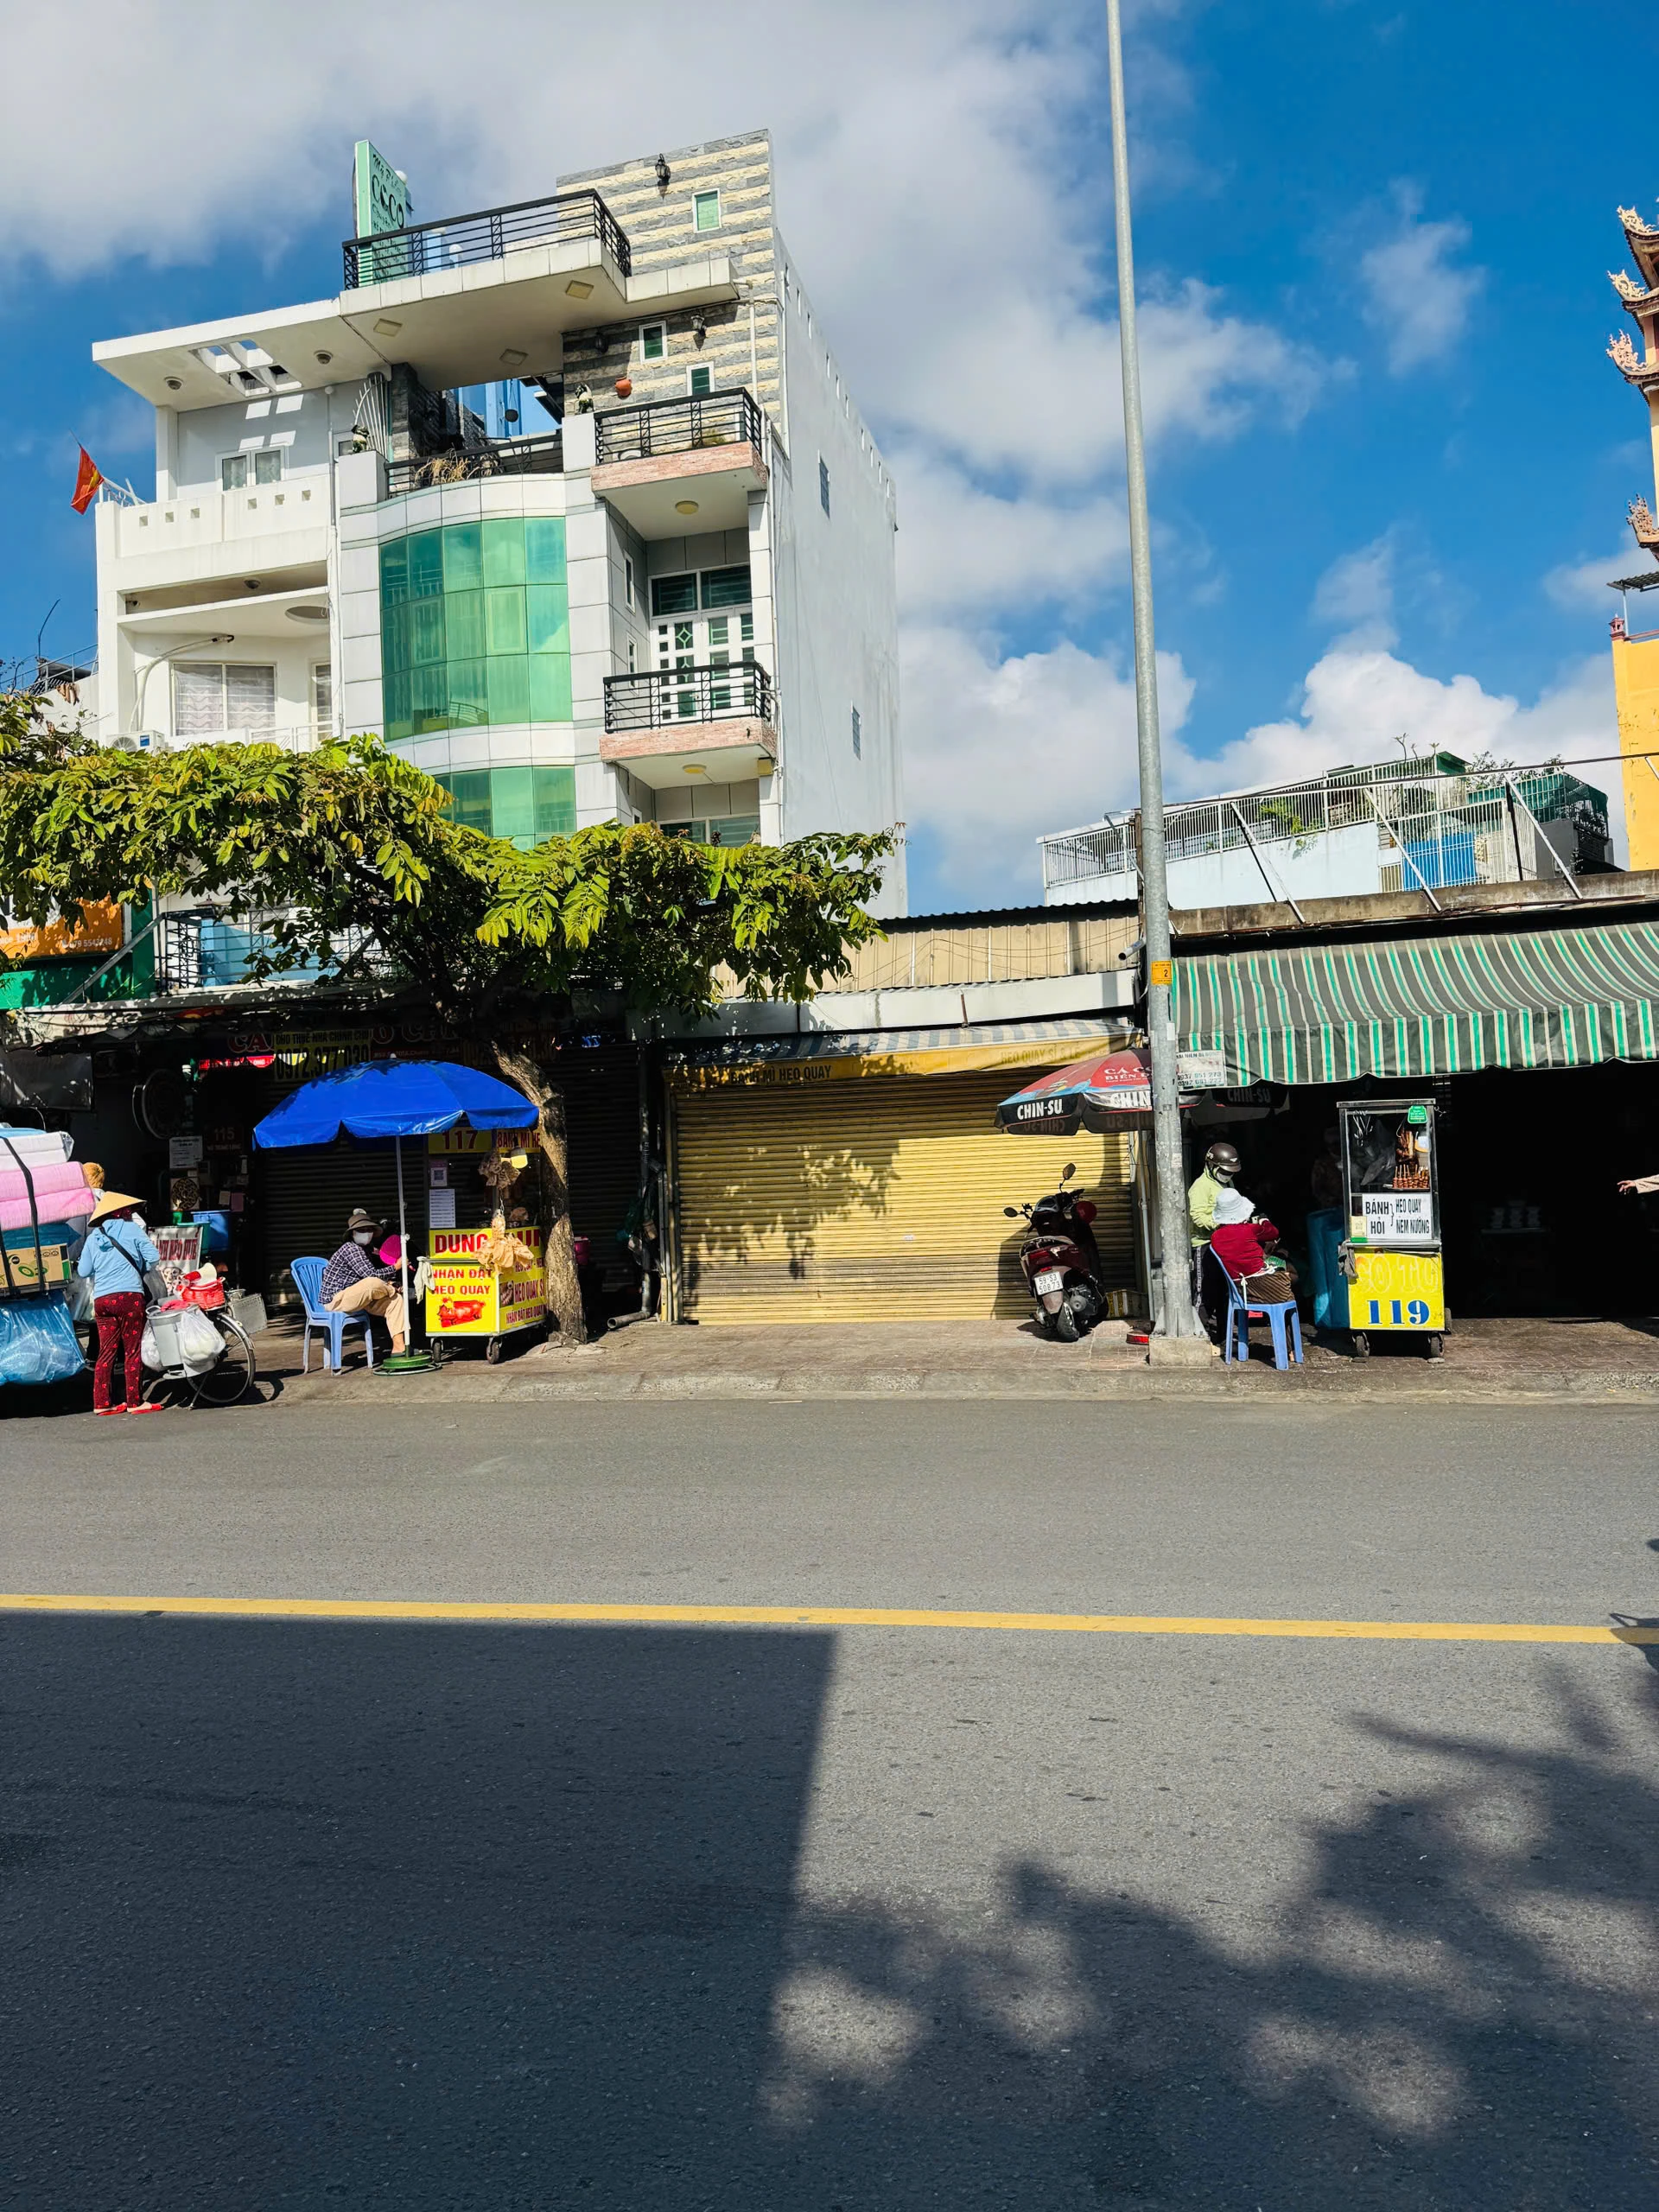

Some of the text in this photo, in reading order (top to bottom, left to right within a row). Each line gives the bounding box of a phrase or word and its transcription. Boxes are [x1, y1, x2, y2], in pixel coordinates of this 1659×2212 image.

[1163, 969, 1168, 977] 2
[779, 1068, 801, 1081] HEO
[804, 1065, 831, 1080] QUAY
[1017, 1098, 1065, 1121] CHIN-SU
[442, 1130, 479, 1150] 117
[1365, 1198, 1389, 1215] BÁNH
[1395, 1198, 1422, 1214] HEO QUAY
[1370, 1217, 1385, 1234] HỎI
[460, 1285, 491, 1296] QUAY
[1039, 1281, 1061, 1294] 50873
[1366, 1300, 1431, 1325] 119
